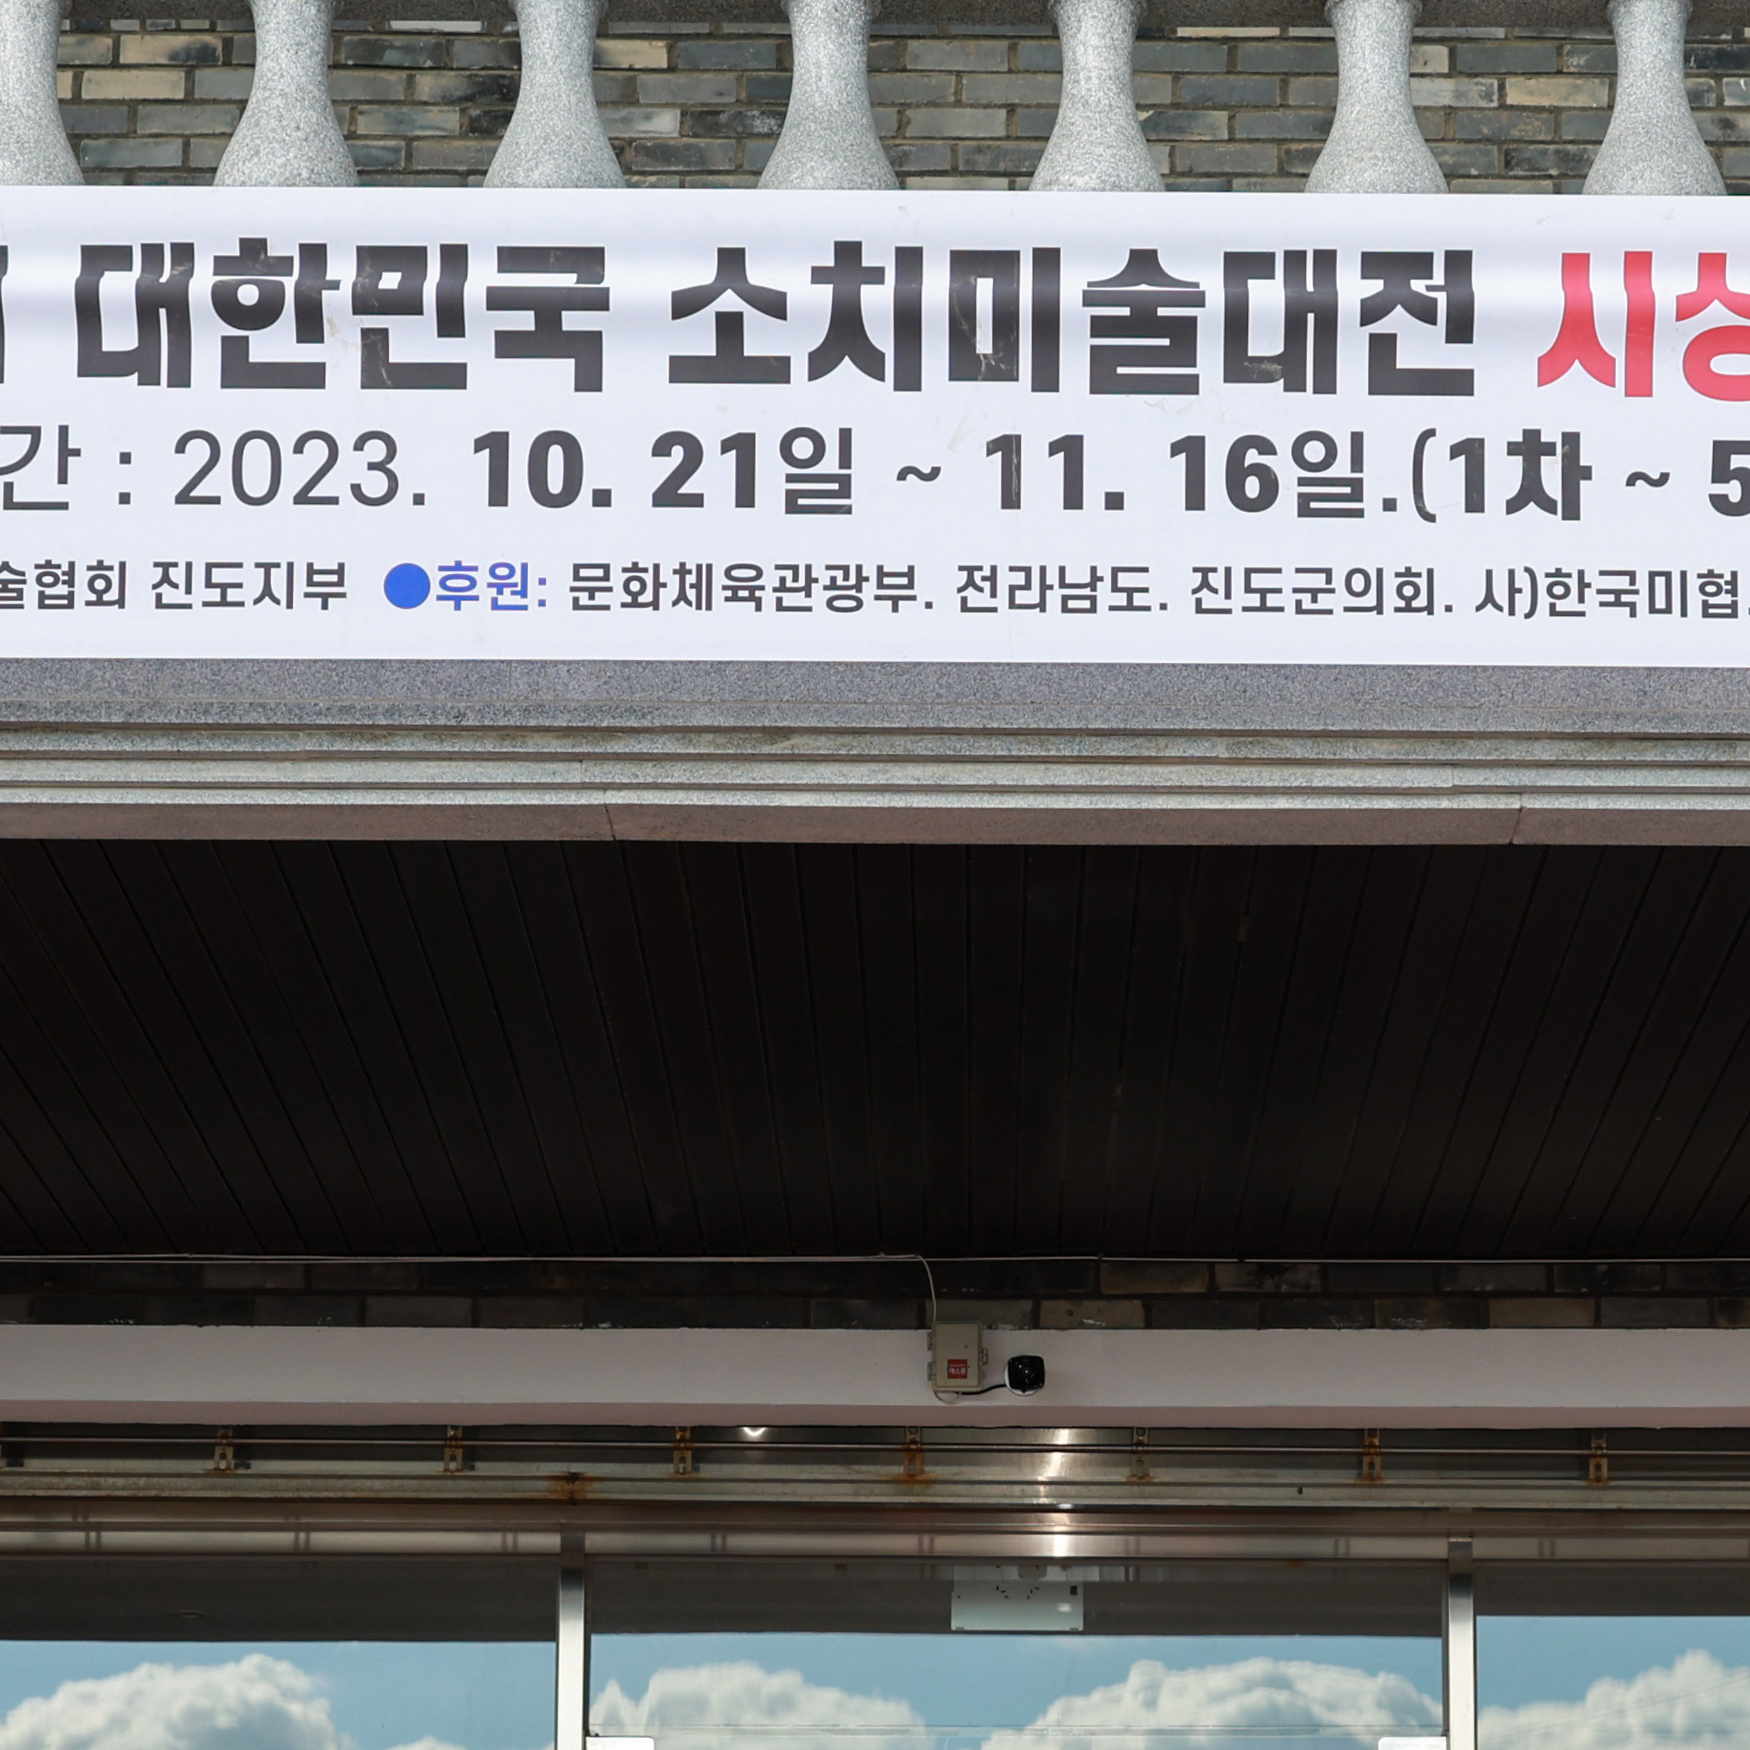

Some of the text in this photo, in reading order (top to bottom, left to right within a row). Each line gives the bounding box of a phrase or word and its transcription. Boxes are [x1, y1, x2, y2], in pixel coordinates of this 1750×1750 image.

[76, 239, 611, 393] 대한민국
[670, 242, 1476, 397] 소치미술대전
[176, 431, 426, 507] 2023.
[475, 431, 613, 509] 10.
[653, 428, 853, 516] 21일
[987, 435, 1125, 511] 11.
[153, 562, 348, 611] 진도지부
[437, 562, 547, 612] 후원:
[571, 563, 934, 614] 문화체육관광부.
[958, 566, 1168, 615] 전라남도.
[1193, 567, 1454, 616] 진도군의회.
